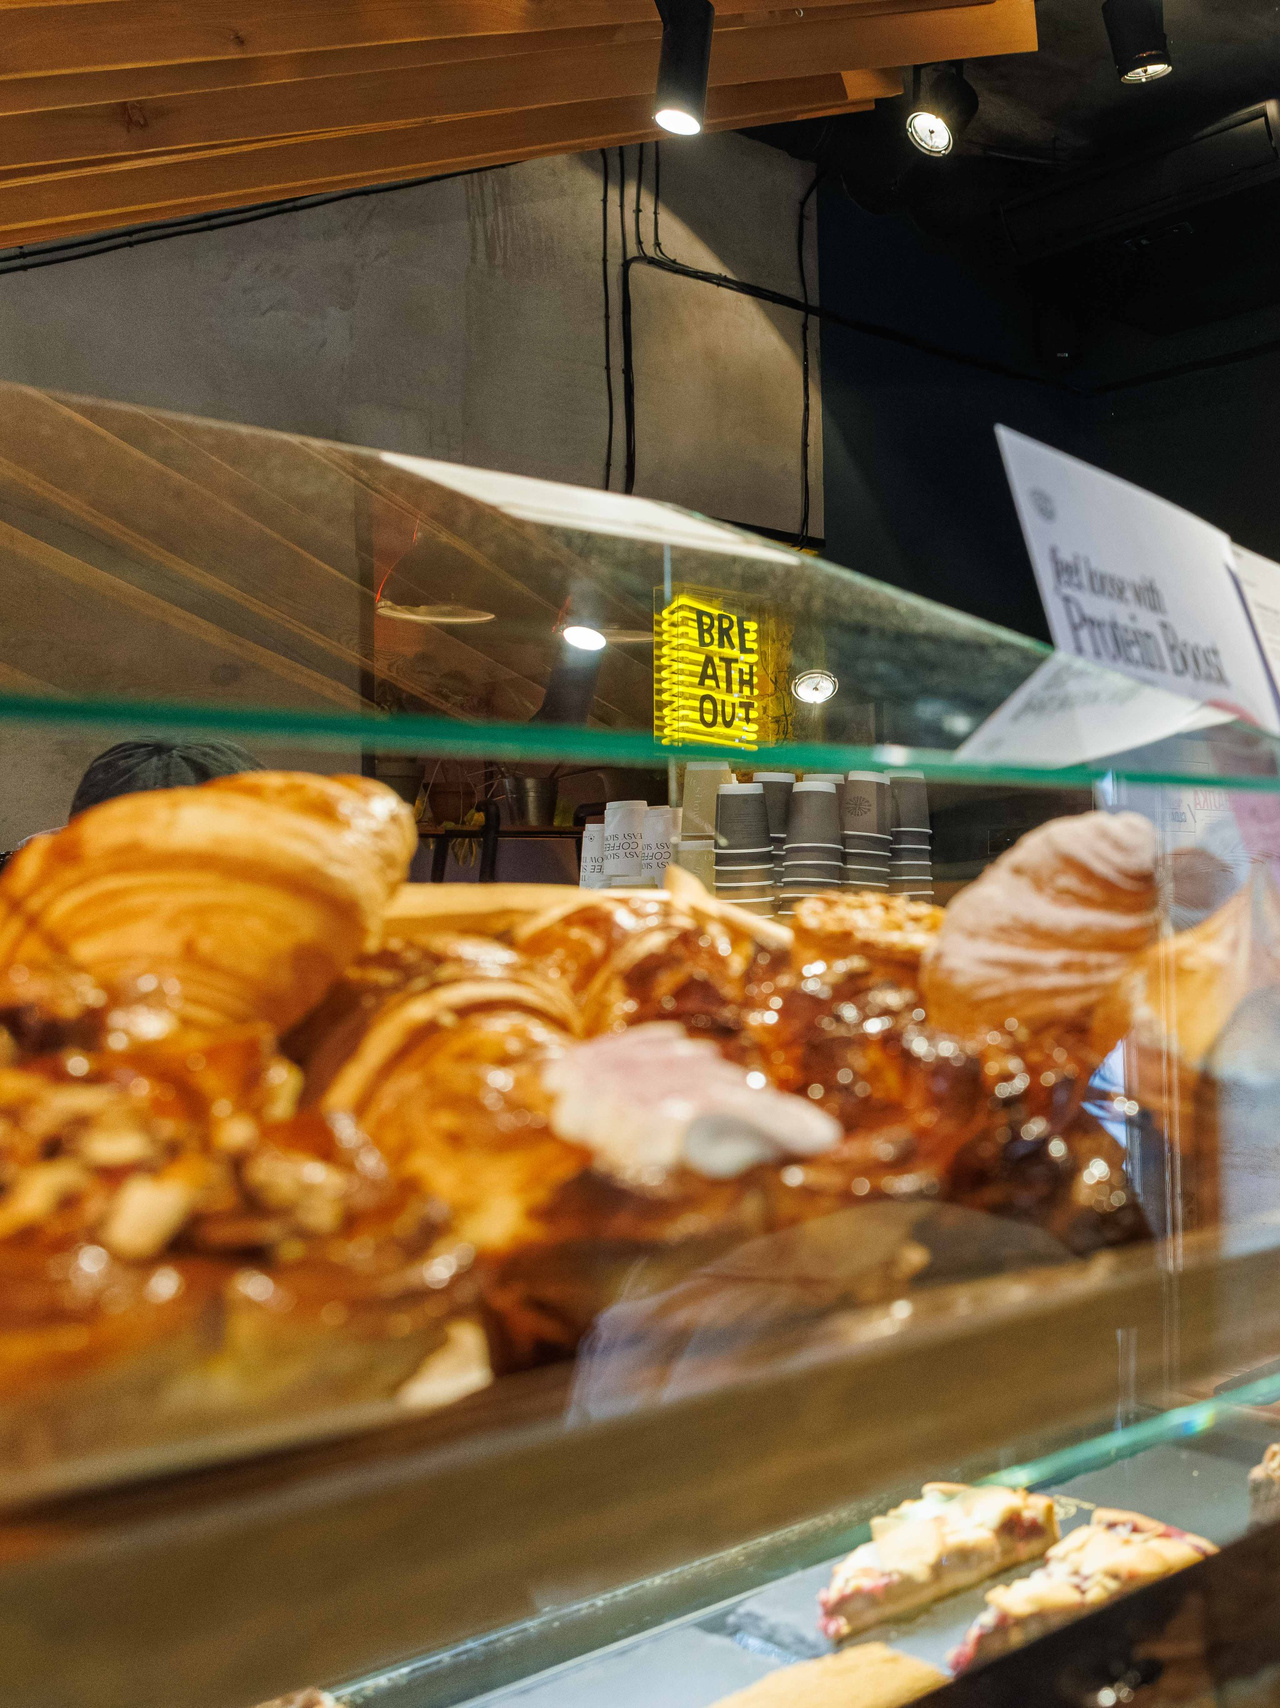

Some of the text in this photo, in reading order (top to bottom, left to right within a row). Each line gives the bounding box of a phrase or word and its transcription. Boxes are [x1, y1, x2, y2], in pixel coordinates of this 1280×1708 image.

[696, 610, 755, 654] BRE
[1062, 595, 1168, 672] Protein
[1158, 617, 1231, 686] Boost
[698, 654, 754, 696] ATH
[699, 693, 755, 729] OUT
